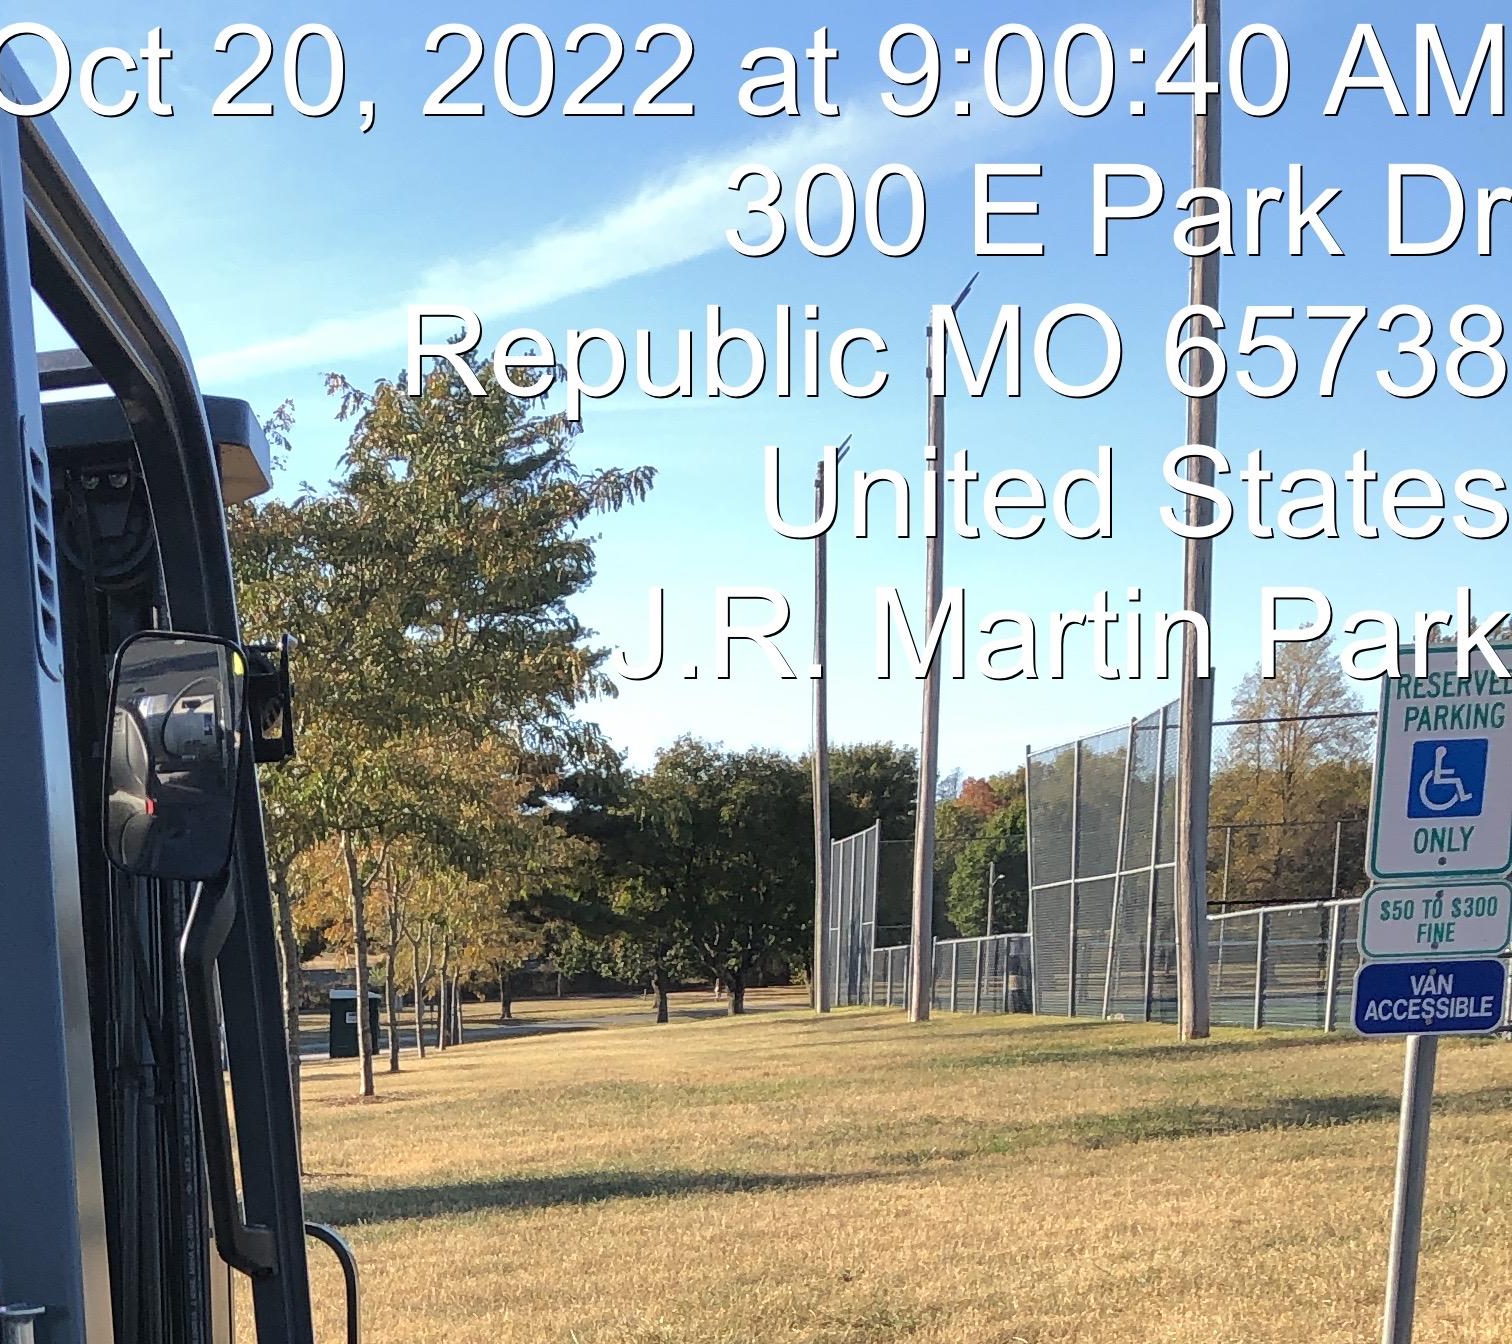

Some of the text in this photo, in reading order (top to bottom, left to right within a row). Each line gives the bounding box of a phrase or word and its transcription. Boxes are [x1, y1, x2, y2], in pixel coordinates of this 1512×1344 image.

[1403, 702, 1506, 732] PARKING
[1413, 826, 1475, 854] ONLY
[1380, 896, 1498, 921] $50 TO $300
[1416, 922, 1456, 944] FINE
[1410, 973, 1454, 996] VAN
[1364, 995, 1494, 1022] ACCESSIBLE
